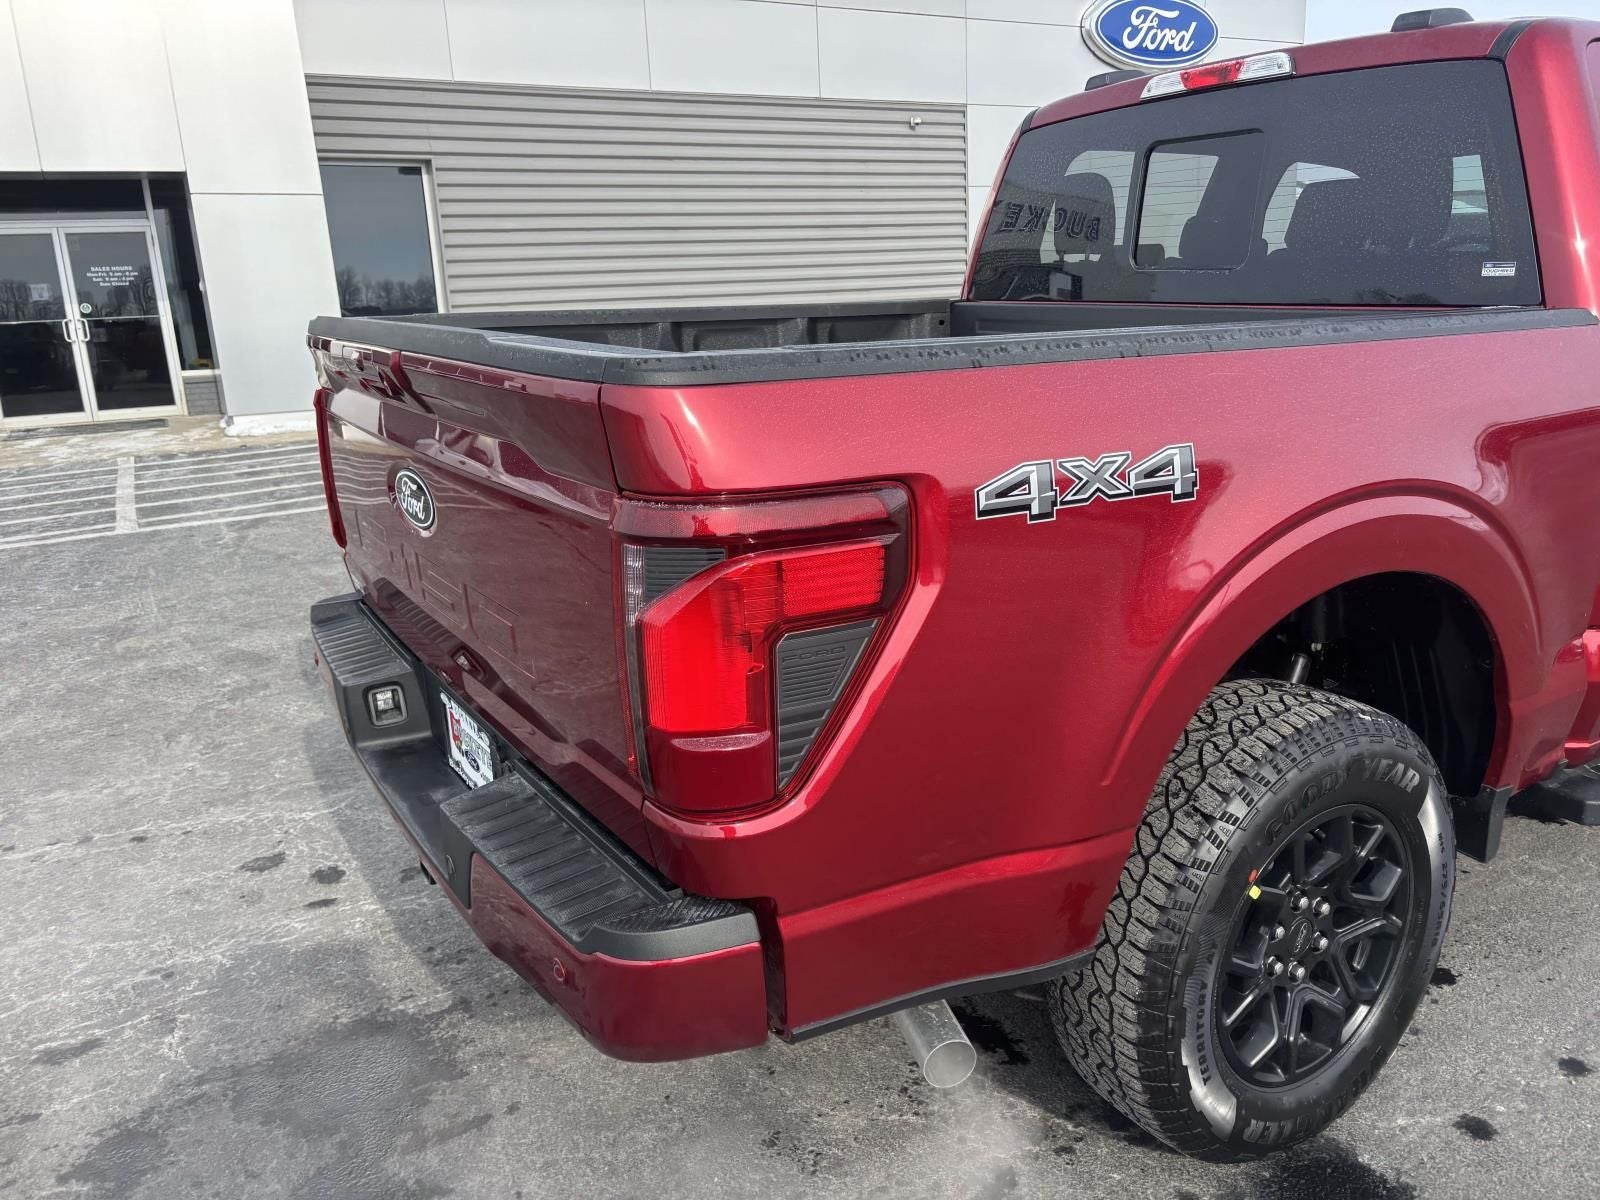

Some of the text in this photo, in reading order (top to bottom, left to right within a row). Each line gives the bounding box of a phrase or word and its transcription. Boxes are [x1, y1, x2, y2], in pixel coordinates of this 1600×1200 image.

[1122, 6, 1197, 52] Ford
[401, 477, 425, 520] Ford
[1196, 979, 1212, 1086] TERRITORY
